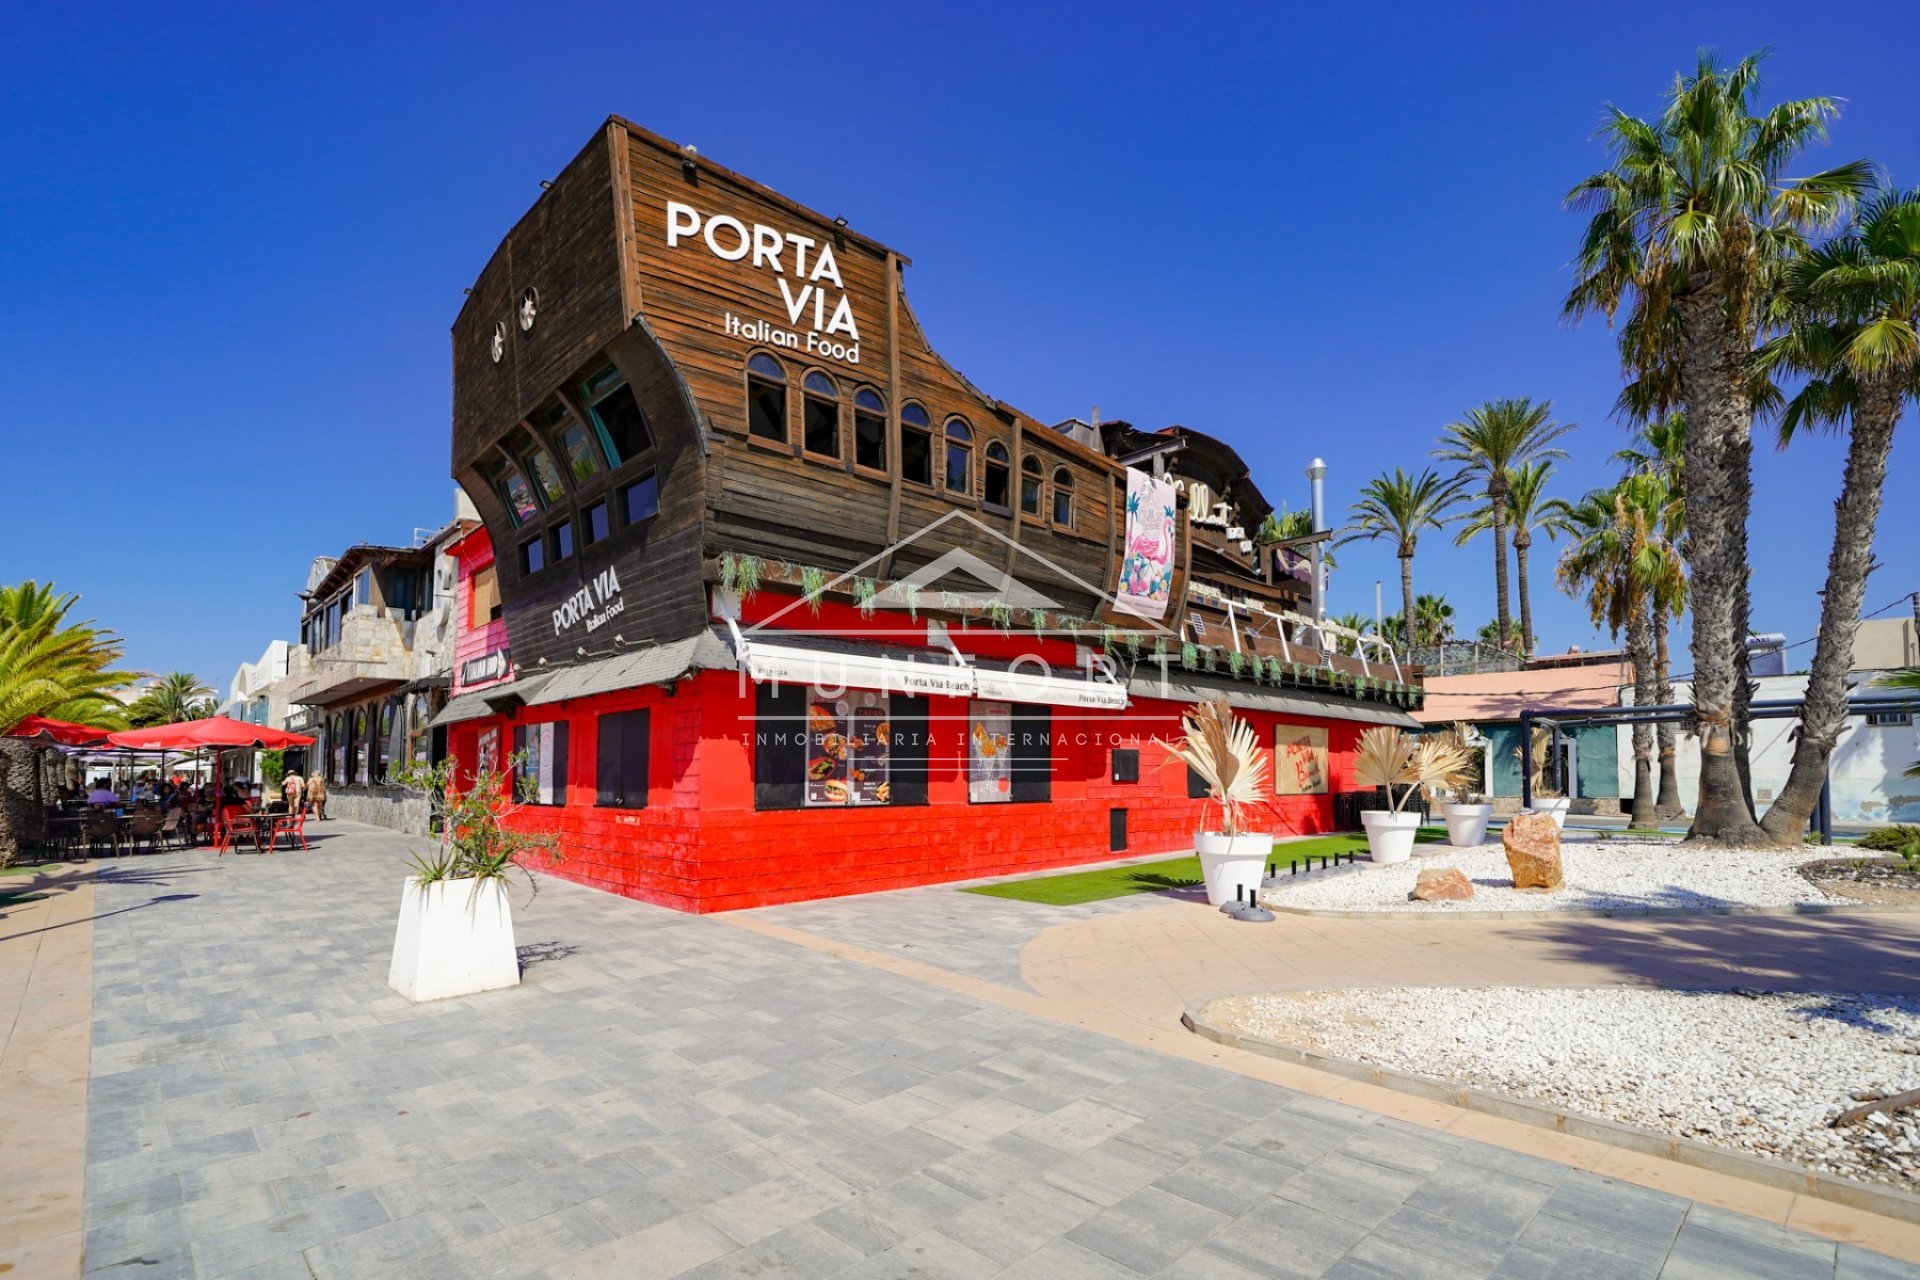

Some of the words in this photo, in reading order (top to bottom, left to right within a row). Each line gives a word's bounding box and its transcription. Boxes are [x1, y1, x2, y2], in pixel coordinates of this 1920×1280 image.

[667, 200, 844, 289] PORTA
[725, 312, 798, 349] Italian
[807, 331, 860, 364] Food
[777, 277, 860, 341] VIA
[552, 584, 595, 636] PORTA
[593, 564, 621, 605] VIA
[605, 596, 624, 620] Food
[904, 676, 928, 687] Porta
[929, 678, 944, 689] Via
